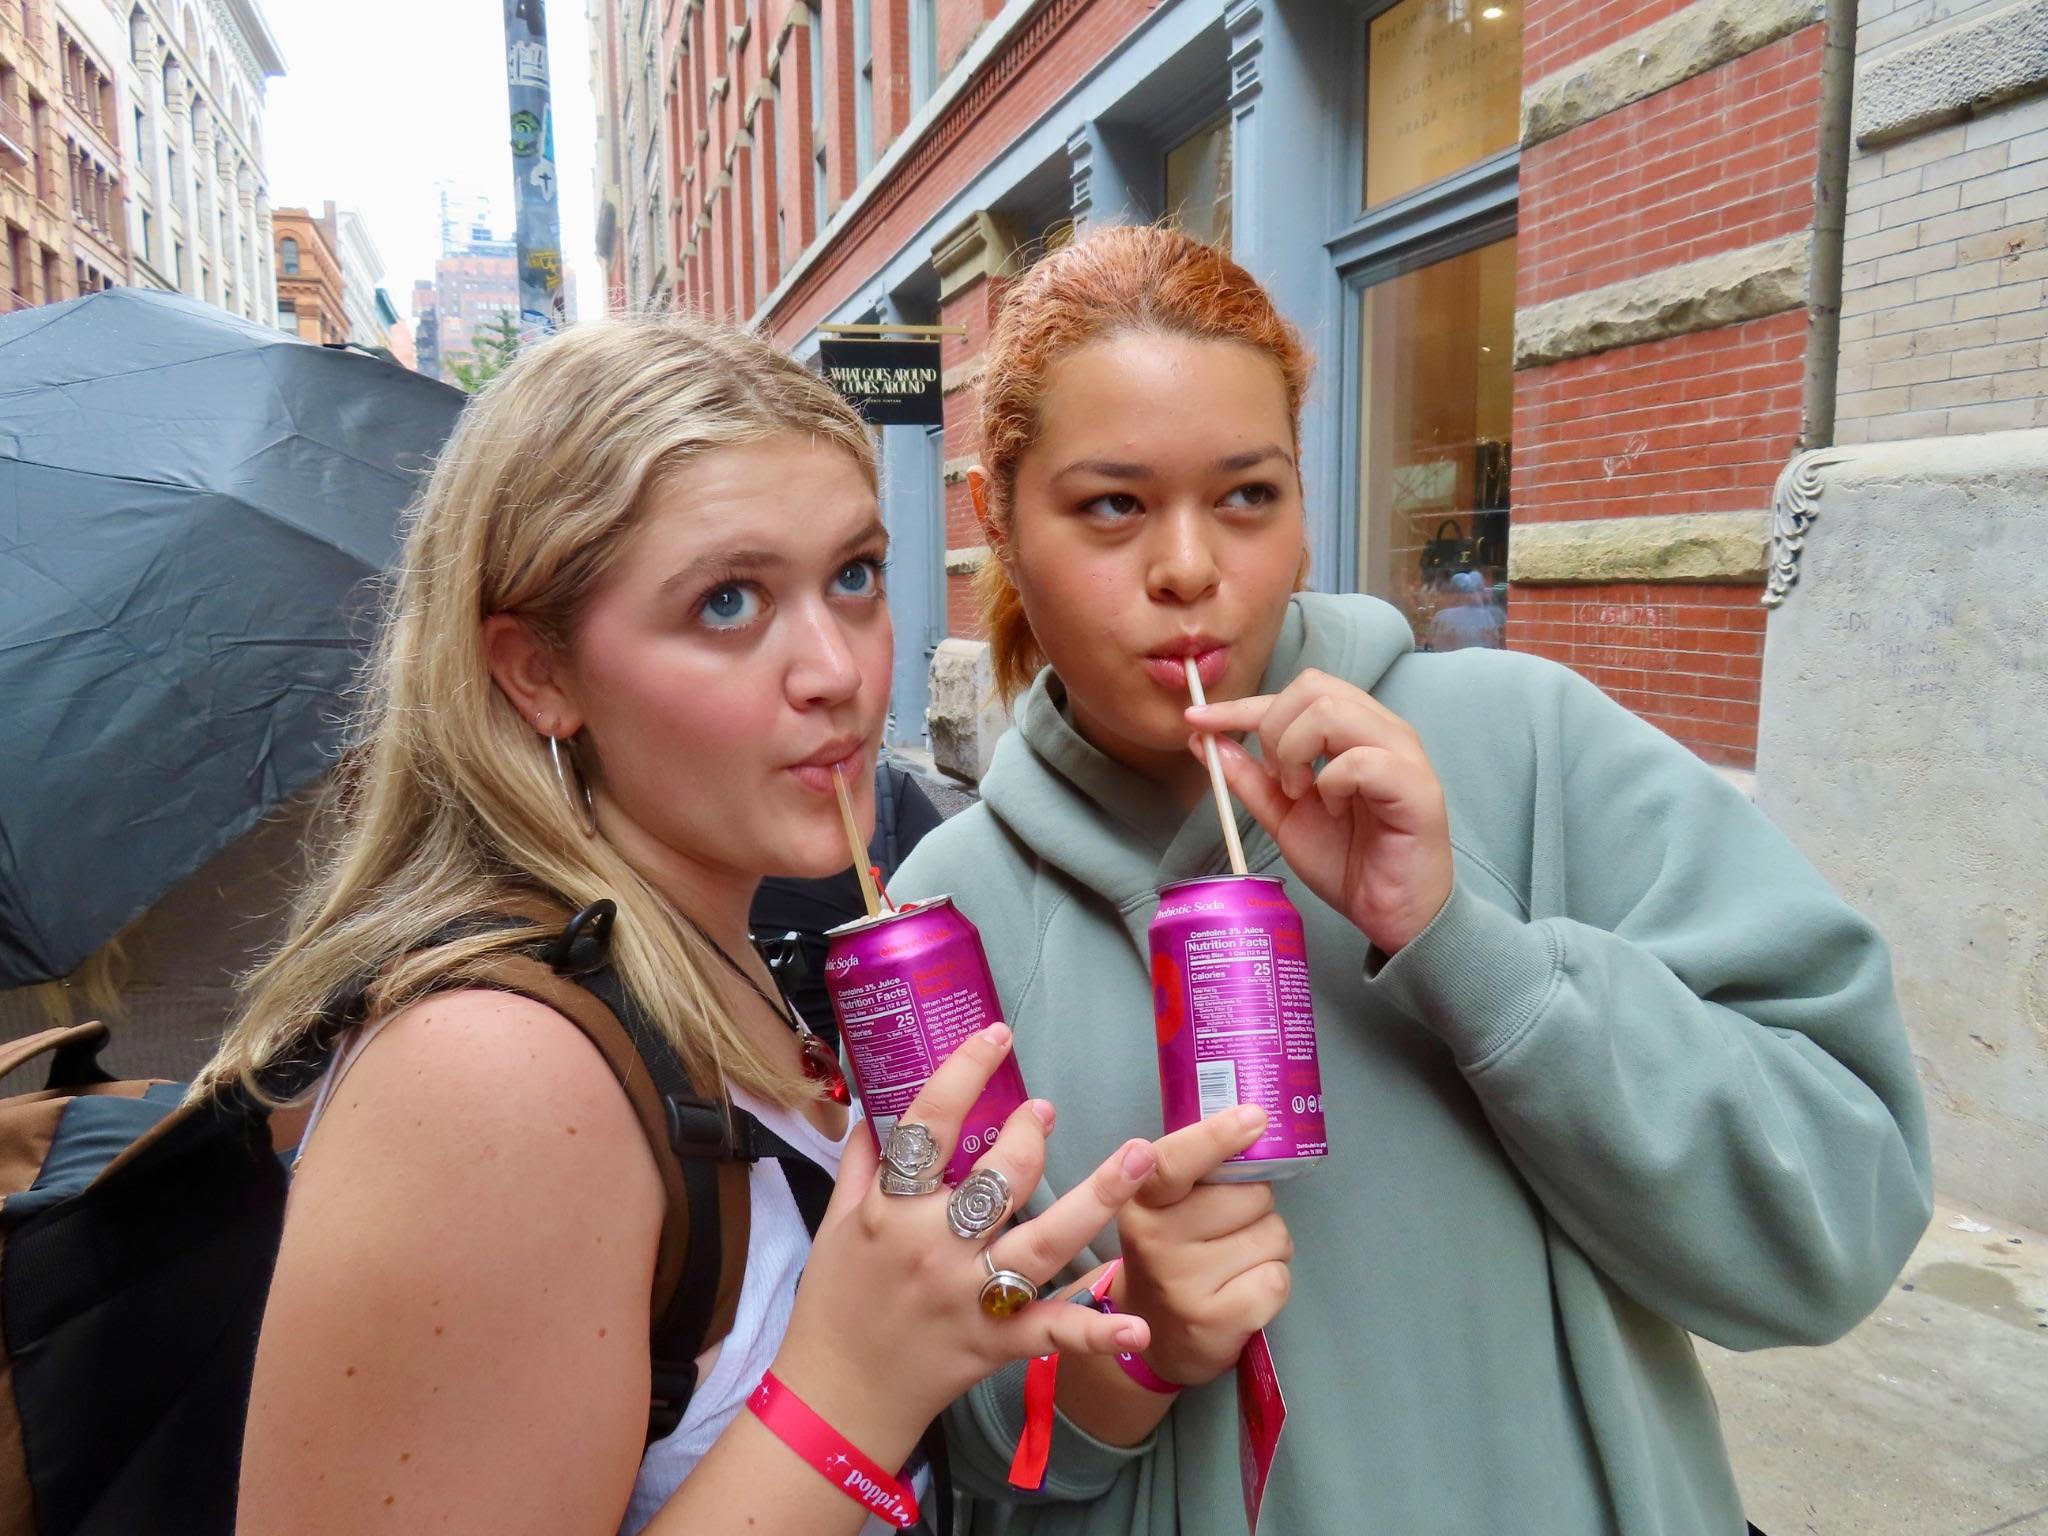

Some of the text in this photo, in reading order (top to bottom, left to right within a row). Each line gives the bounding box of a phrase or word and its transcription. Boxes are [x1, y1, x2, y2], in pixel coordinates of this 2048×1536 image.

[831, 368, 937, 382] WHAT GOES AROUND
[842, 381, 926, 394] COMES AROUND
[1194, 900, 1224, 911] Soda
[1190, 930, 1226, 939] Contains
[1188, 940, 1236, 952] Nutrition
[1239, 938, 1268, 947] Facts
[837, 953, 859, 970] Soda
[1191, 963, 1271, 980] Calories 25
[838, 977, 900, 998] Contains 3% Juice
[840, 987, 908, 1010] Nutrition Facts
[921, 999, 941, 1009] When
[924, 1002, 954, 1016] maximize
[940, 1003, 971, 1018] everybody
[848, 1012, 915, 1038] Calories 25
[928, 1022, 943, 1031] Ripe
[944, 1014, 963, 1025] cherry
[930, 1029, 944, 1038] with
[932, 1036, 948, 1045] cola
[947, 1031, 957, 1039] for
[957, 1027, 968, 1035] this
[934, 1041, 949, 1051] twist
[950, 1038, 959, 1046] on
